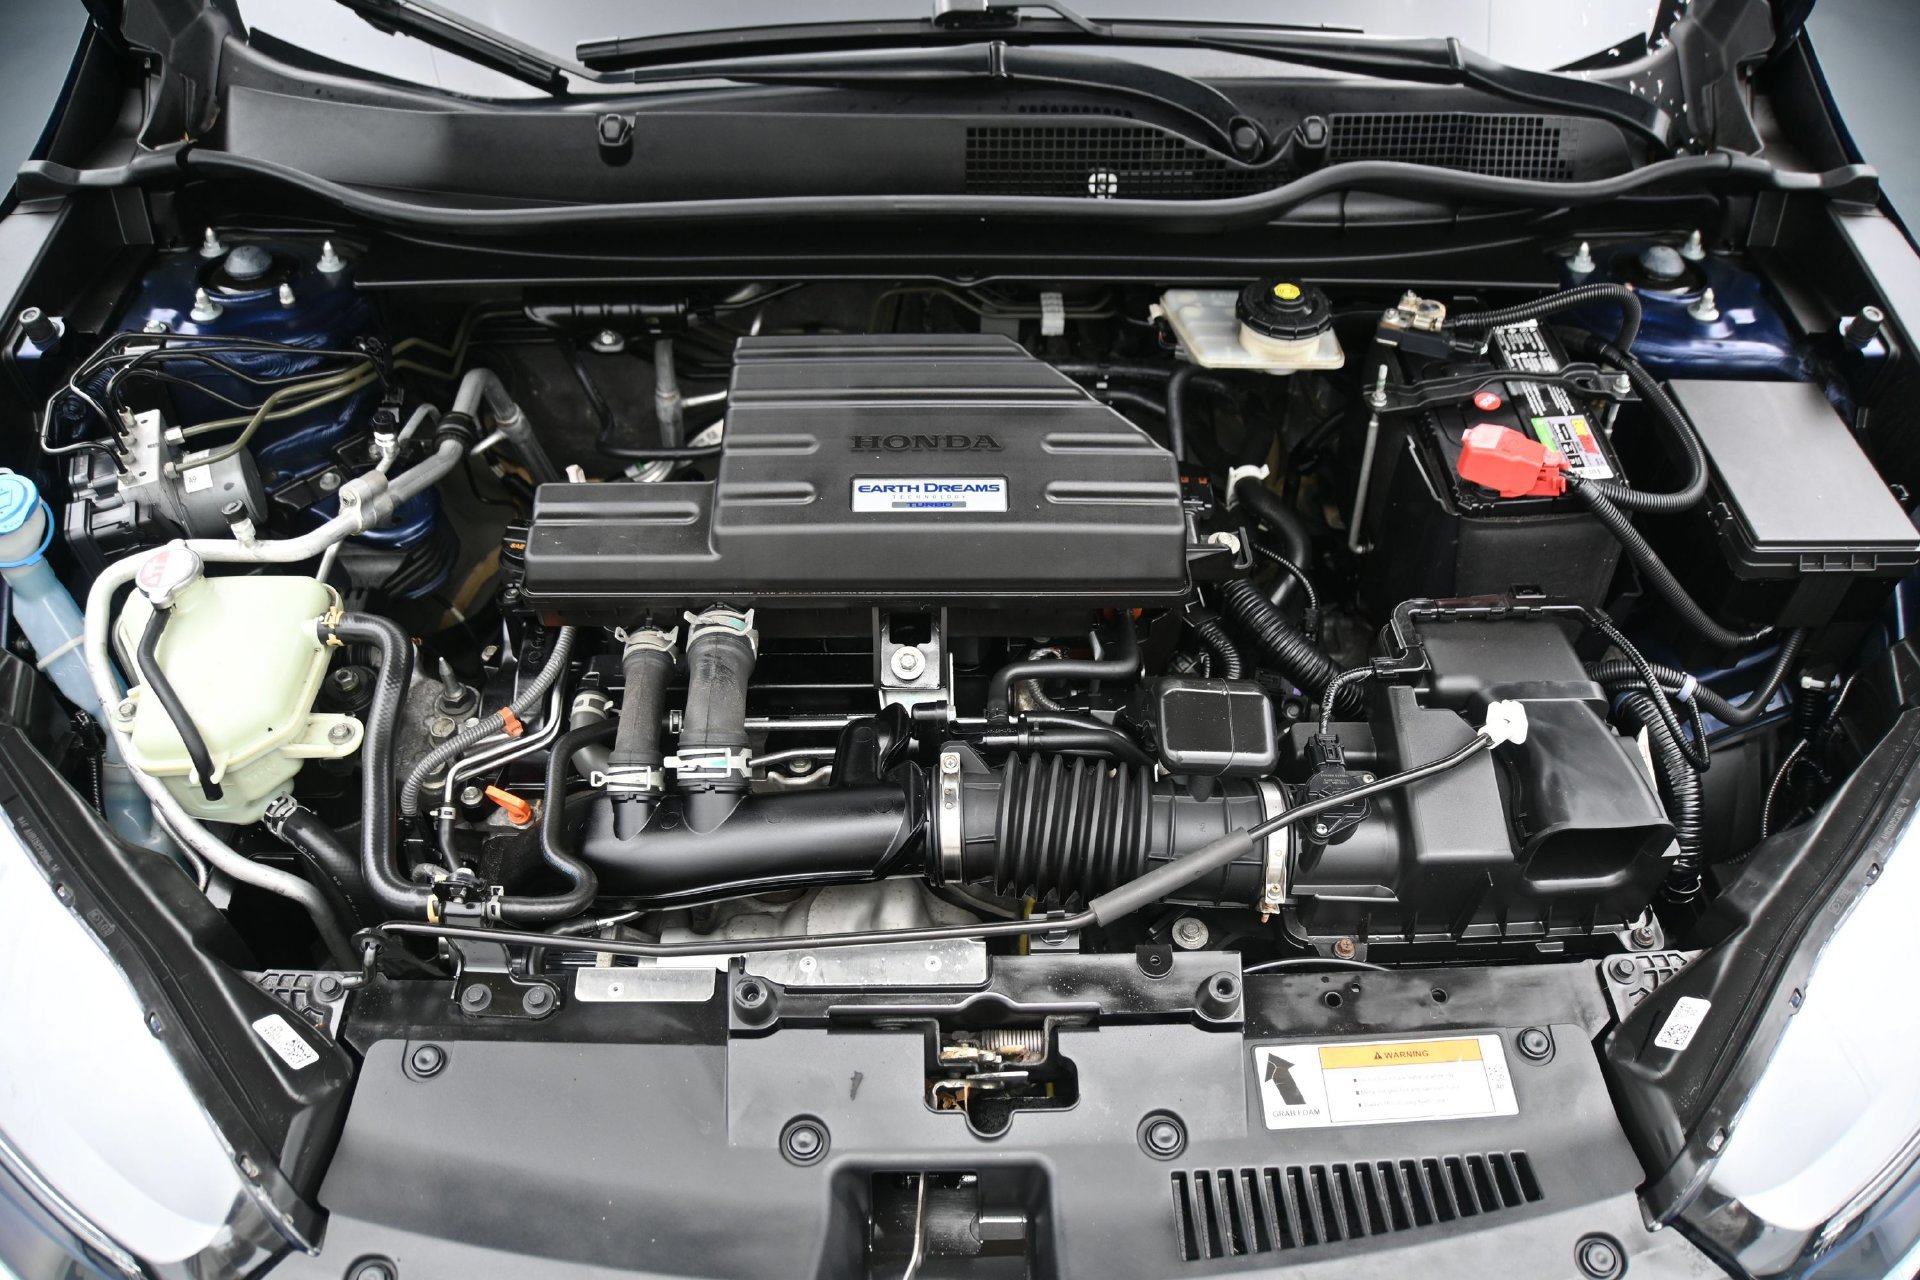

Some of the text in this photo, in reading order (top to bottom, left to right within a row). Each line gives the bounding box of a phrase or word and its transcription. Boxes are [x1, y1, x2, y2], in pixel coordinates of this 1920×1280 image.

[851, 434, 1003, 452] HONDA
[858, 484, 919, 493] EARTH
[1384, 1050, 1429, 1060] WARNING
[1273, 1110, 1297, 1118] GRAB
